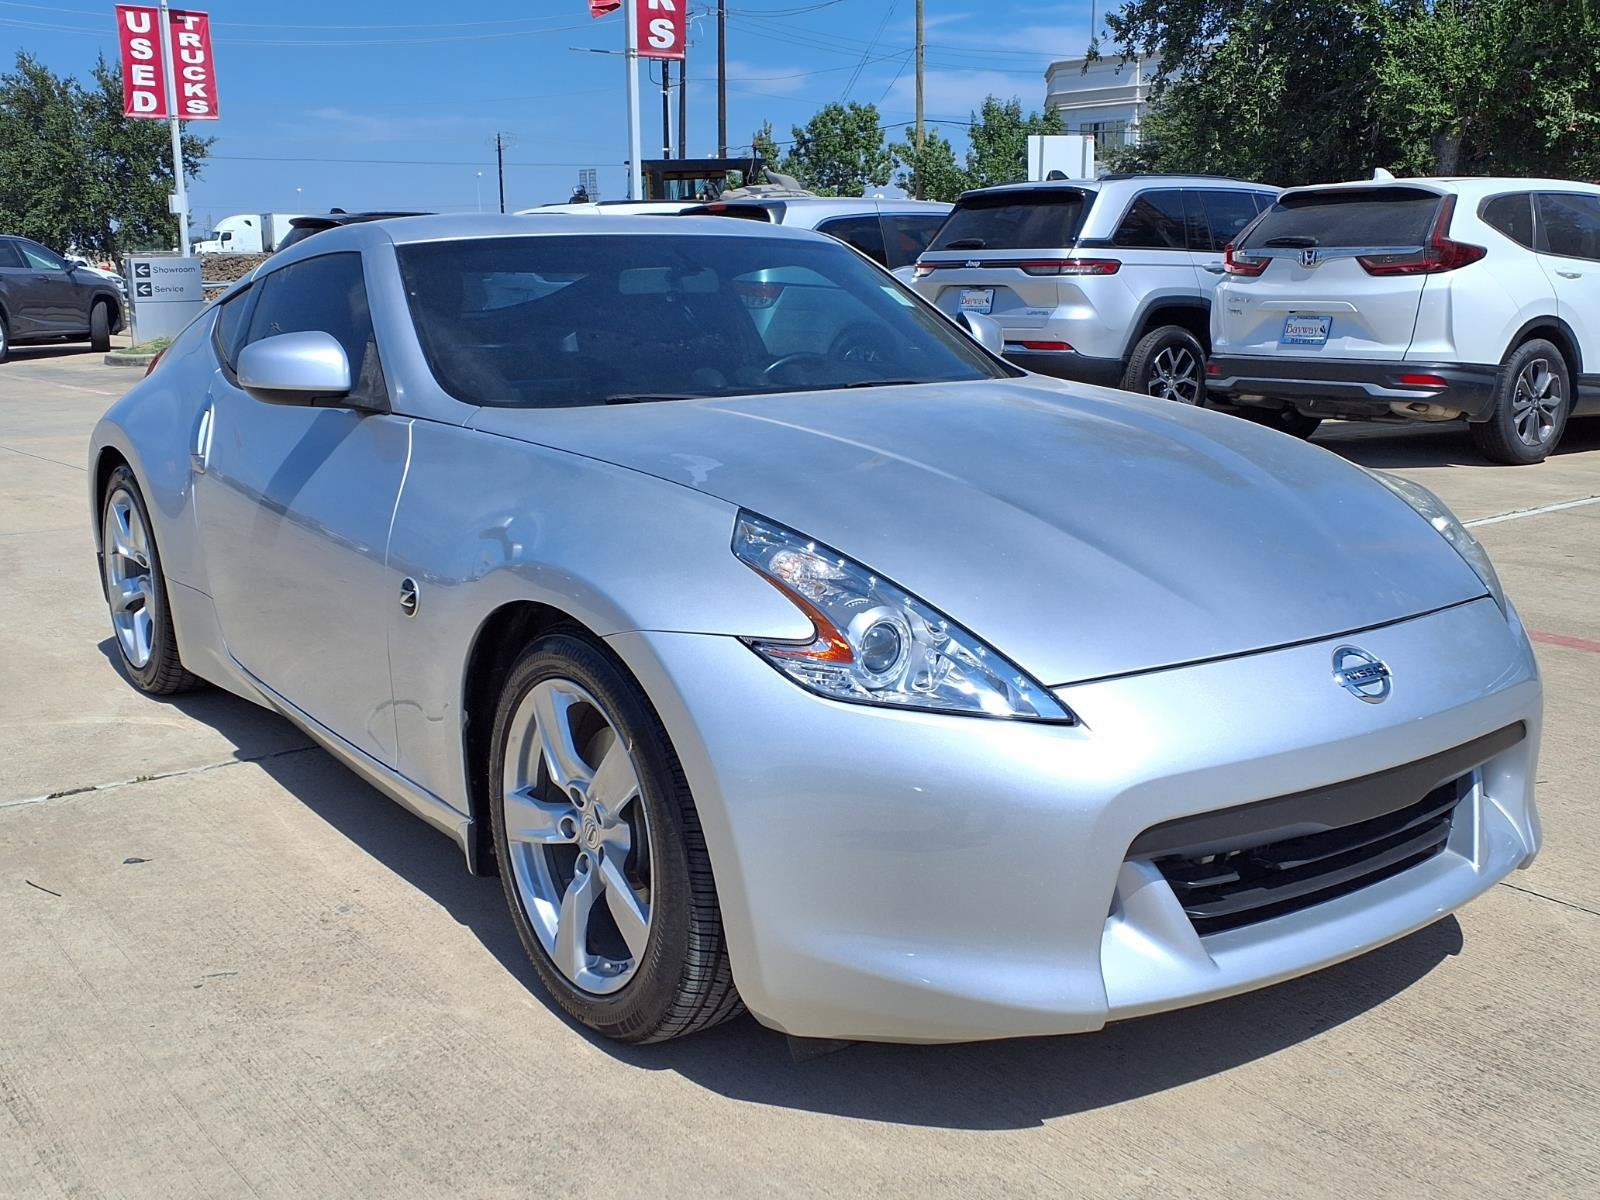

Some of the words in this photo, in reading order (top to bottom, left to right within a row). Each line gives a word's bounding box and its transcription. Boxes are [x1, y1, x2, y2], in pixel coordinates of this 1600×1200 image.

[125, 11, 157, 112] USED
[177, 15, 209, 114] TRUCKS
[152, 265, 196, 274] Showroom
[154, 285, 184, 293] Service
[1286, 323, 1319, 336] Bayway
